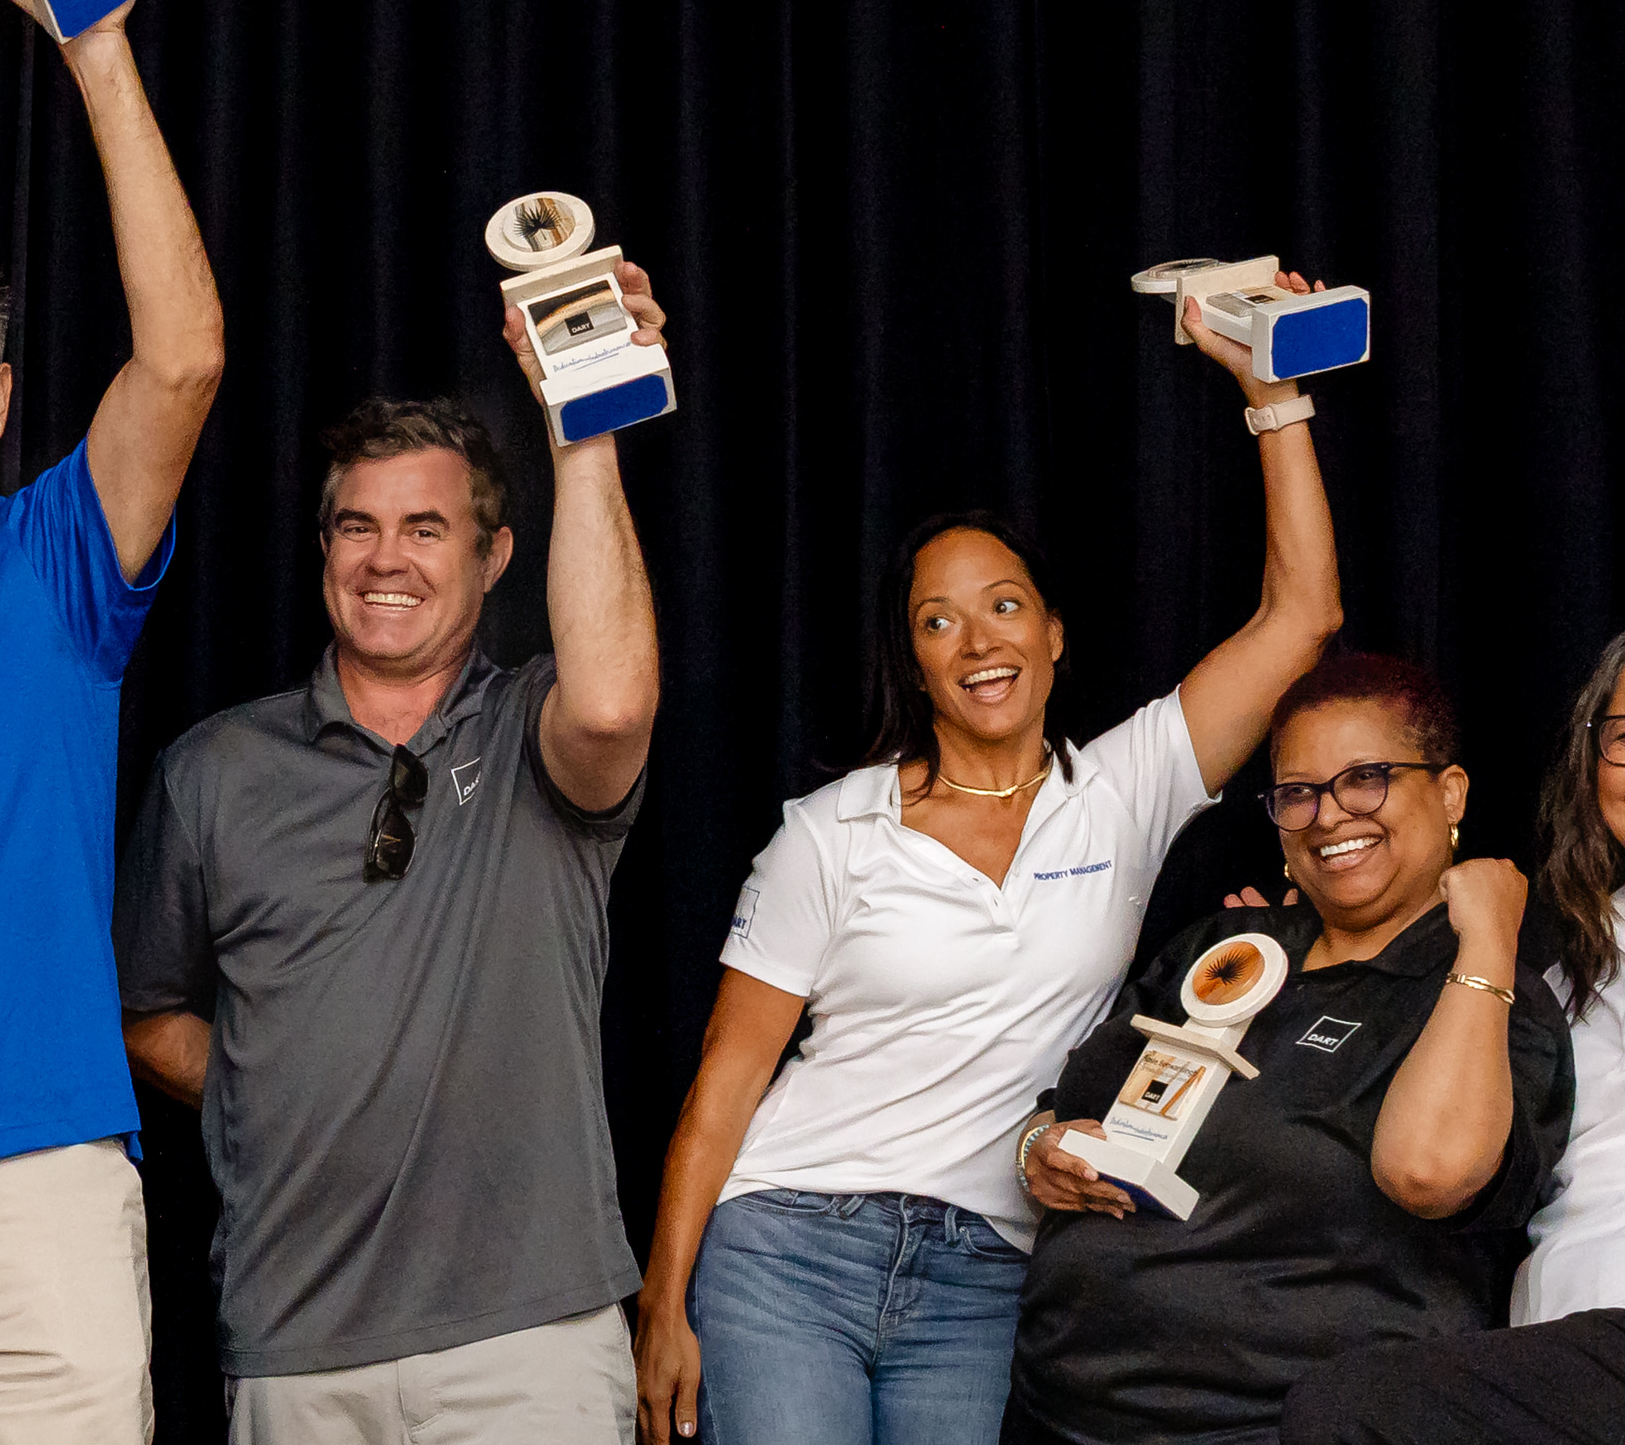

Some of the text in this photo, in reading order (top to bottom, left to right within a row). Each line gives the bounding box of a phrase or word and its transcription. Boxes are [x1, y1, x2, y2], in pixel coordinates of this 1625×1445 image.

[571, 323, 591, 334] DART
[1033, 860, 1112, 881] PROPERTY MANAGEMENT
[1307, 1033, 1339, 1046] DART
